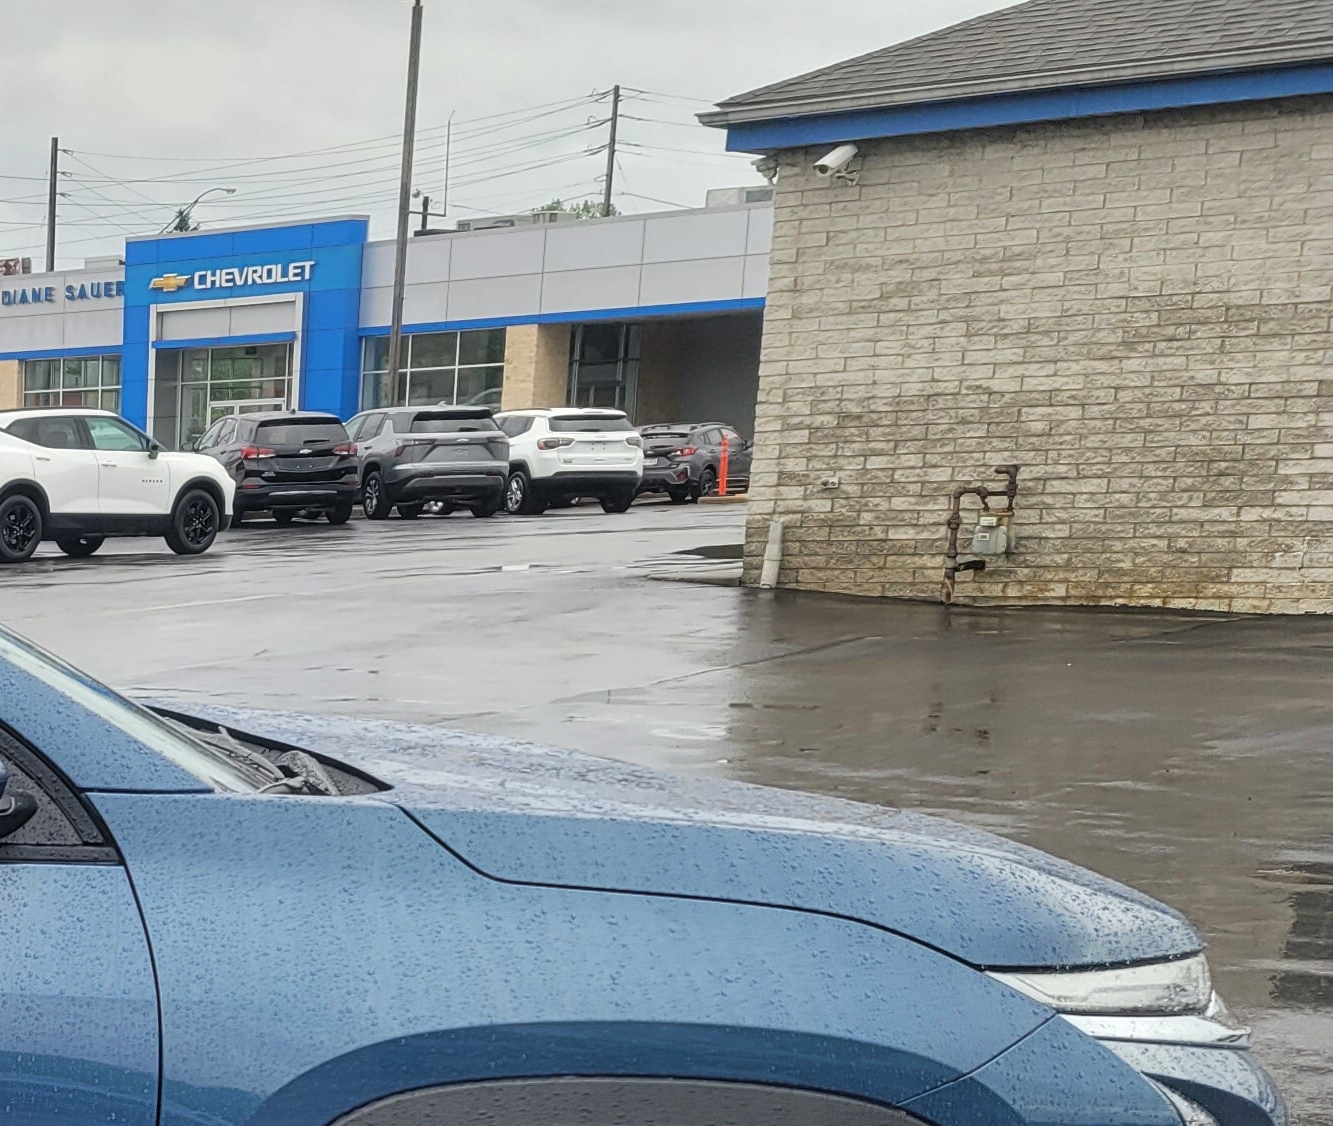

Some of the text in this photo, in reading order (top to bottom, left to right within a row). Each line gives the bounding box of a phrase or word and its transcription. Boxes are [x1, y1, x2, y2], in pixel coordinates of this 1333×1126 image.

[194, 260, 315, 289] CHEVROLET
[1, 280, 125, 306] DIANE SAUER
